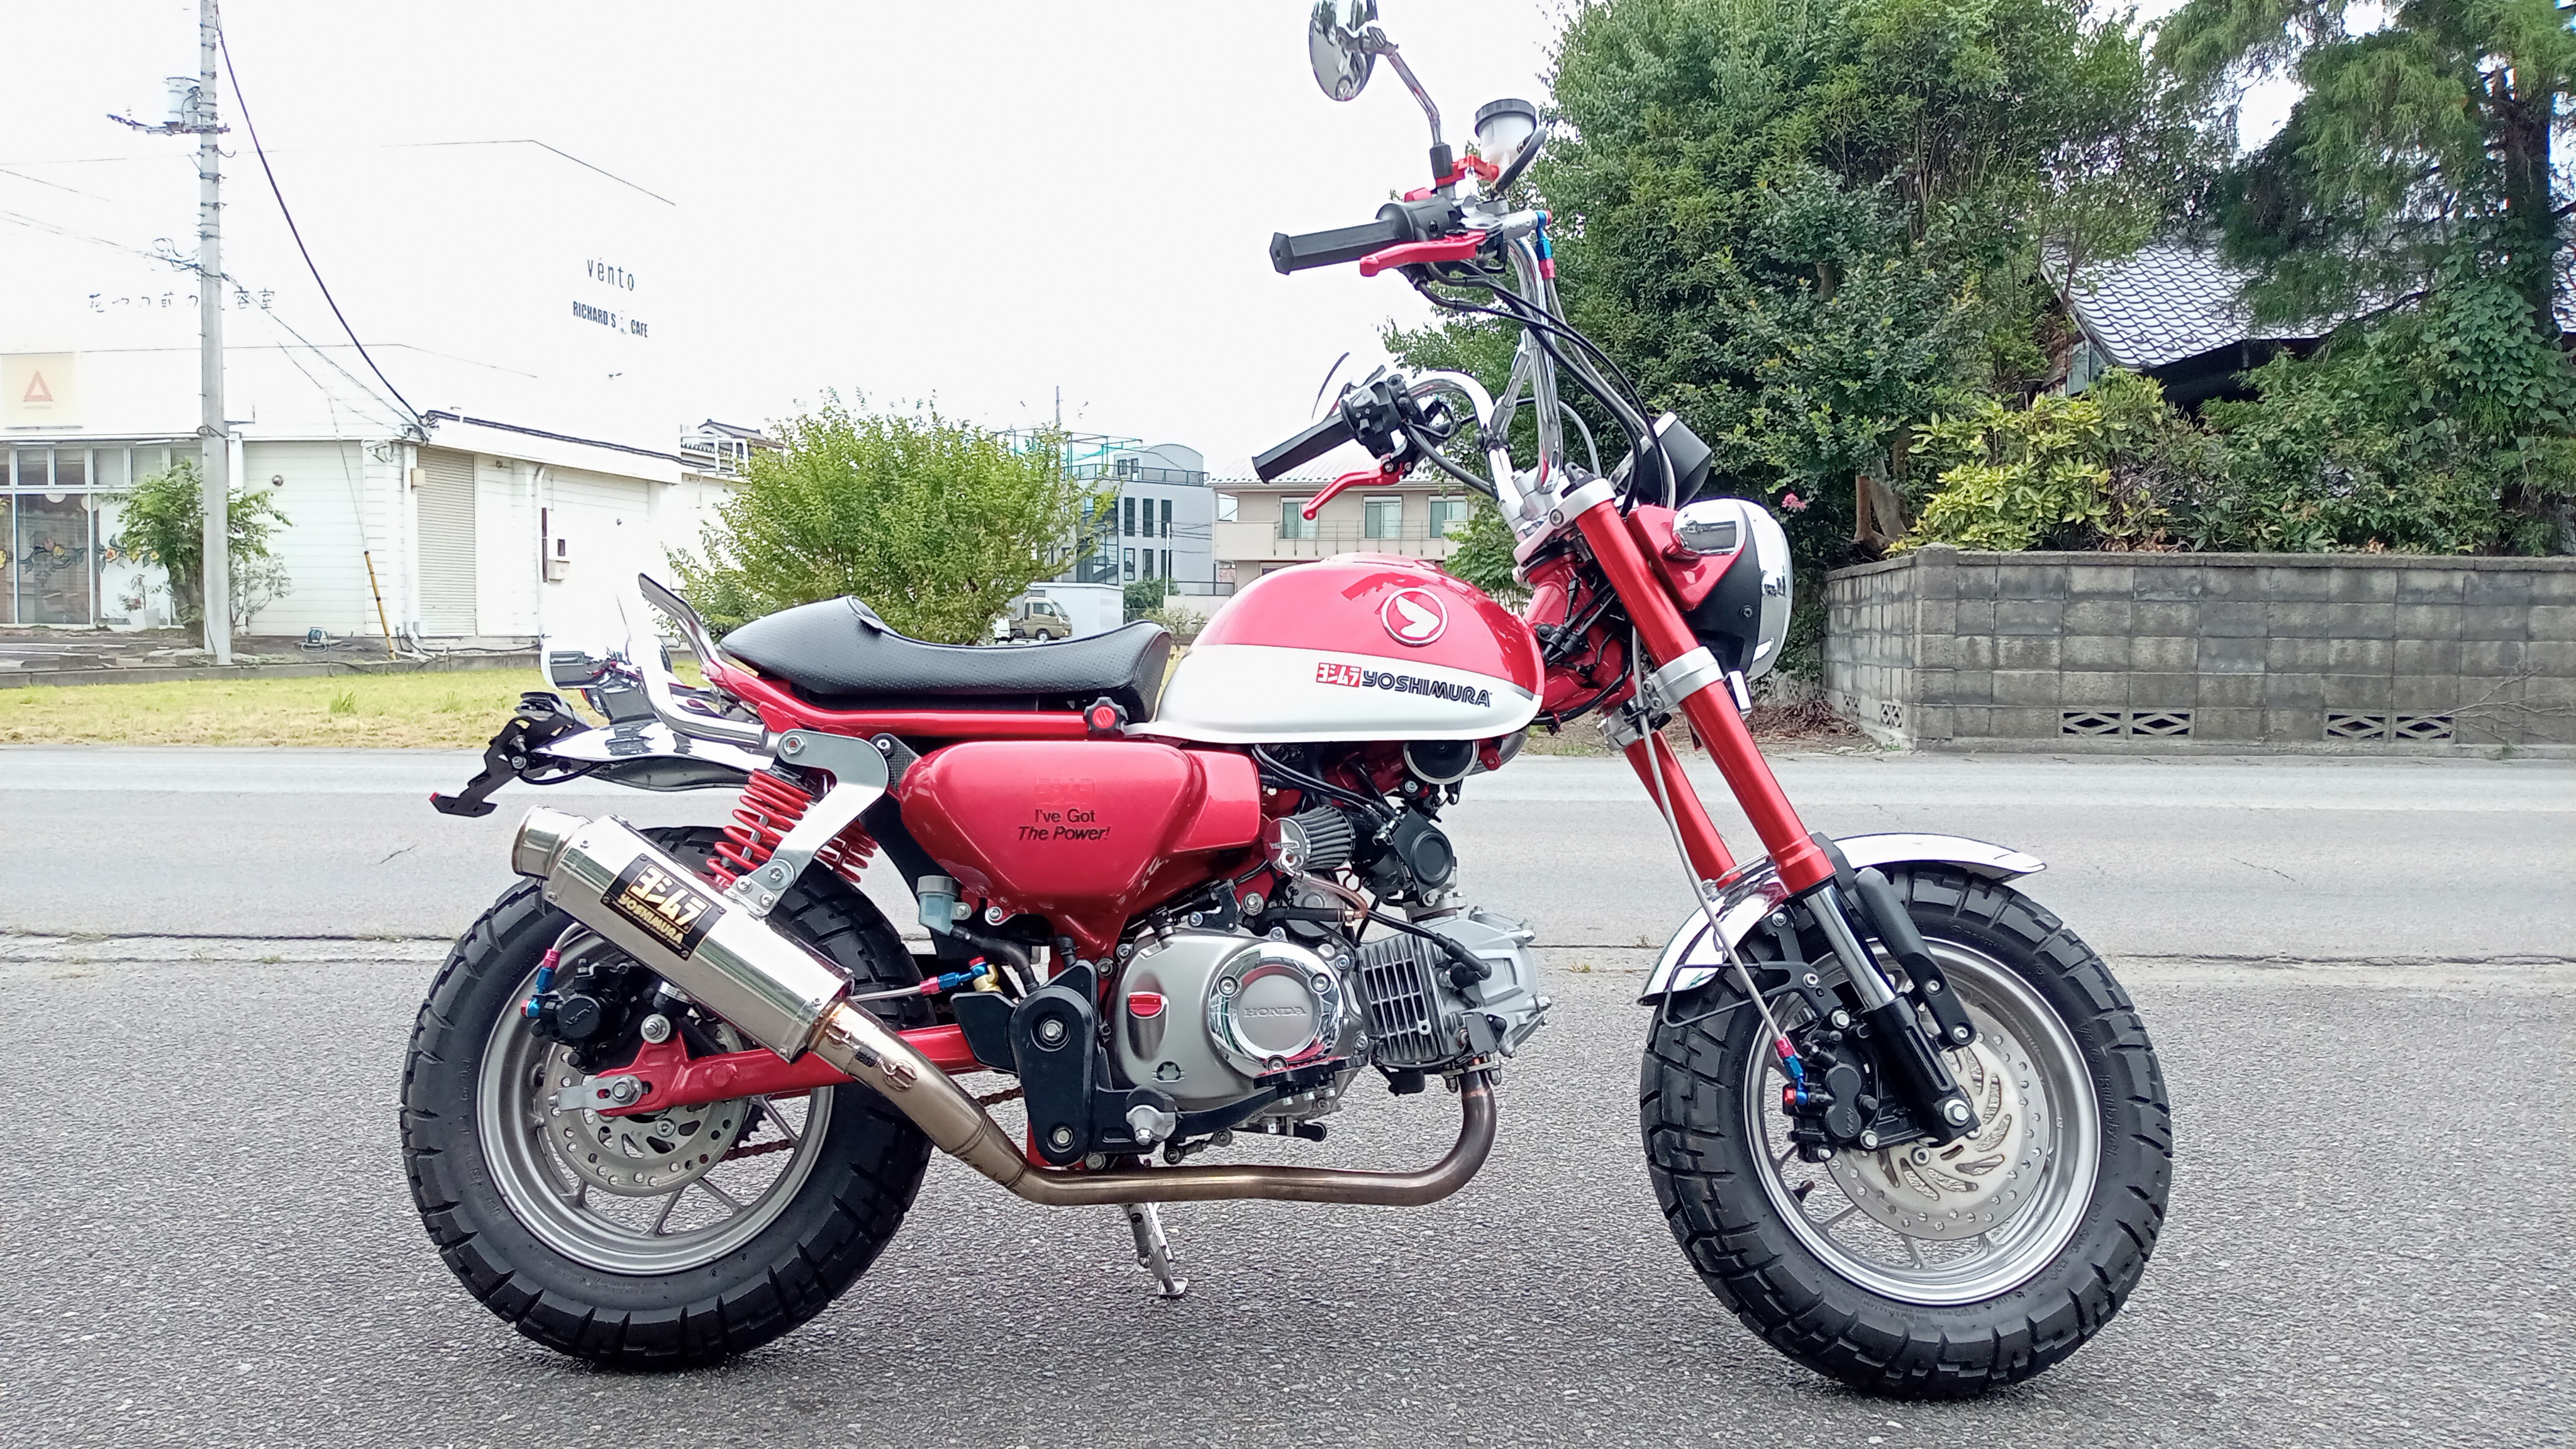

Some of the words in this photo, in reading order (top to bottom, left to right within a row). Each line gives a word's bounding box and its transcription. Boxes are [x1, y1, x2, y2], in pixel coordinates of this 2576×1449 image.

[573, 301, 616, 328] RICHARD'S
[631, 319, 648, 338] CAFE
[1318, 663, 1360, 687] ヨシムラ
[1362, 670, 1491, 708] YOSHIMURA
[1035, 809, 1061, 823] I've
[1067, 808, 1096, 823] Got
[1018, 826, 1049, 840] The
[1053, 825, 1111, 841] Power!
[630, 867, 707, 926] ヨシムラ
[618, 894, 684, 945] YOSHIMURA
[1243, 1006, 1306, 1018] HONDA
